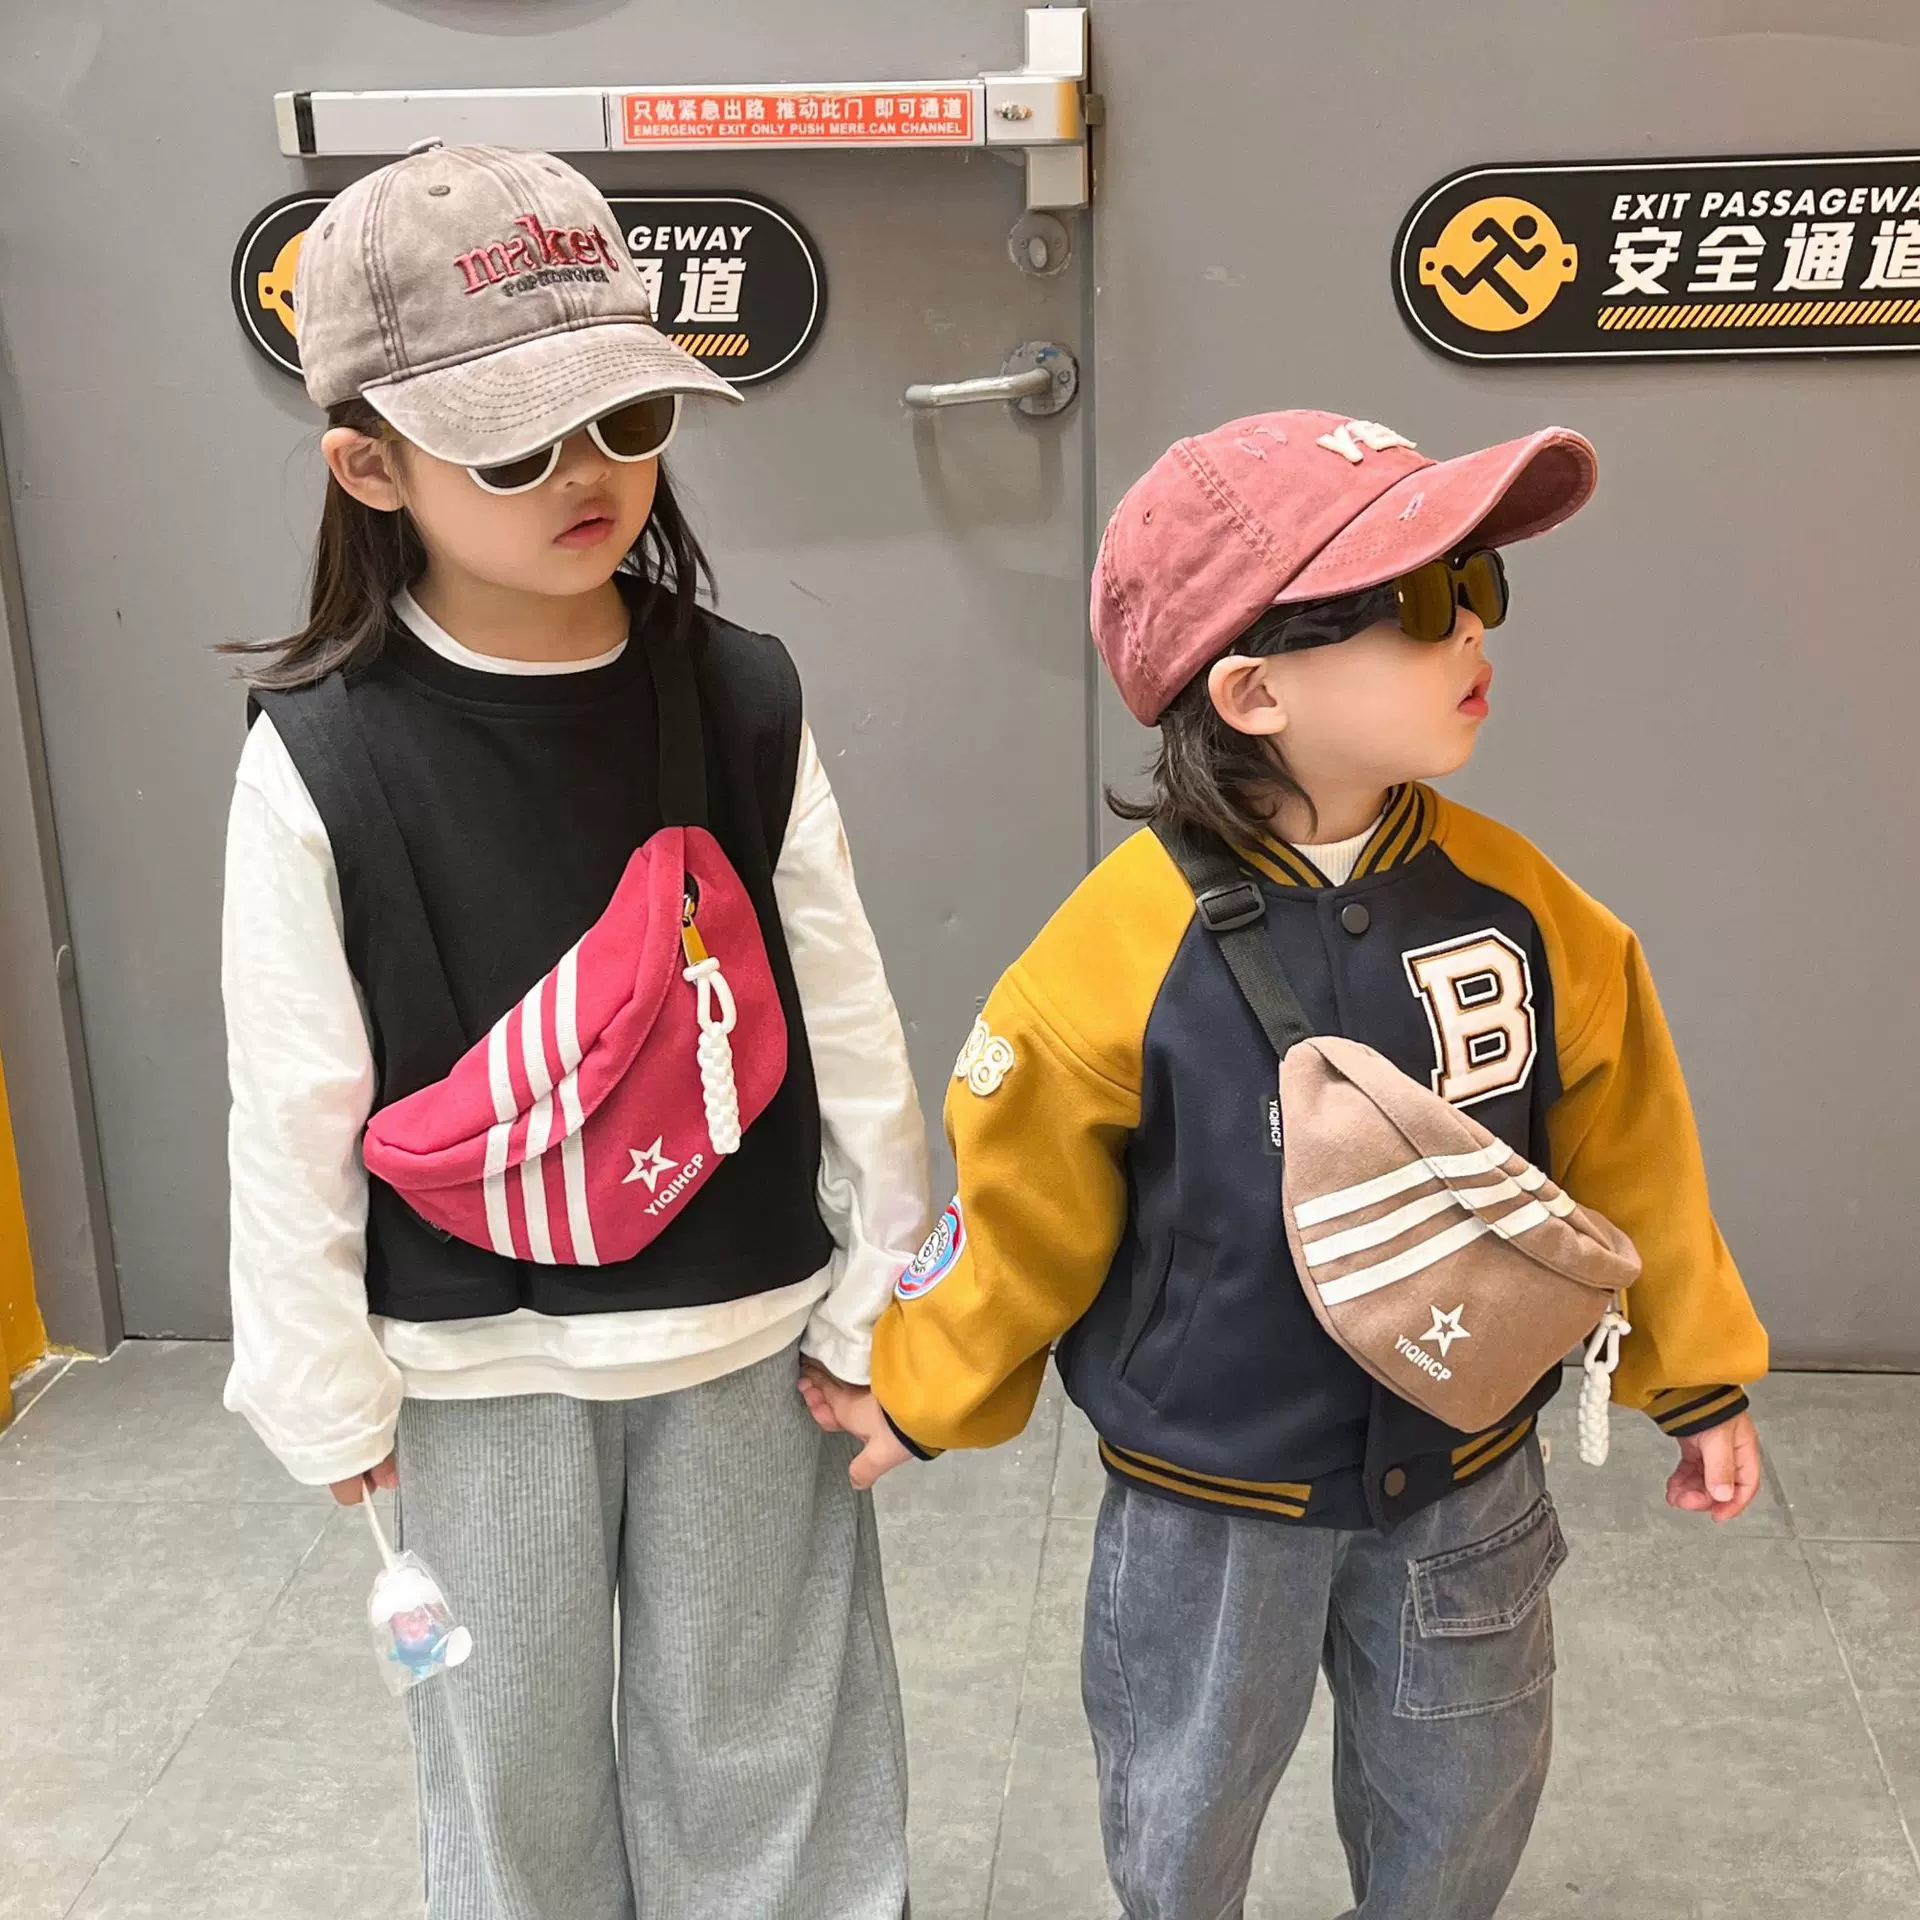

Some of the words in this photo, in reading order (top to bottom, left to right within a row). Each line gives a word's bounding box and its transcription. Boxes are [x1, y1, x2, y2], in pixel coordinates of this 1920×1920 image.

[633, 123, 714, 136] EMERGENCY
[719, 123, 746, 135] EXIT
[751, 123, 785, 135] ONLY
[790, 122, 824, 135] PUSH
[901, 121, 962, 134] CHANNEL
[634, 98, 766, 120] 只做紧急出路
[776, 97, 863, 120] 推动此门
[875, 97, 963, 119] 即可通道
[1611, 192, 1692, 220] EXIT
[1700, 186, 1920, 219] PASSAGEWA
[1602, 219, 1920, 296] 安全通道
[1401, 927, 1538, 1110] B
[643, 1153, 704, 1216] YIQIHCP
[1394, 1334, 1452, 1382] YIQIHCP
